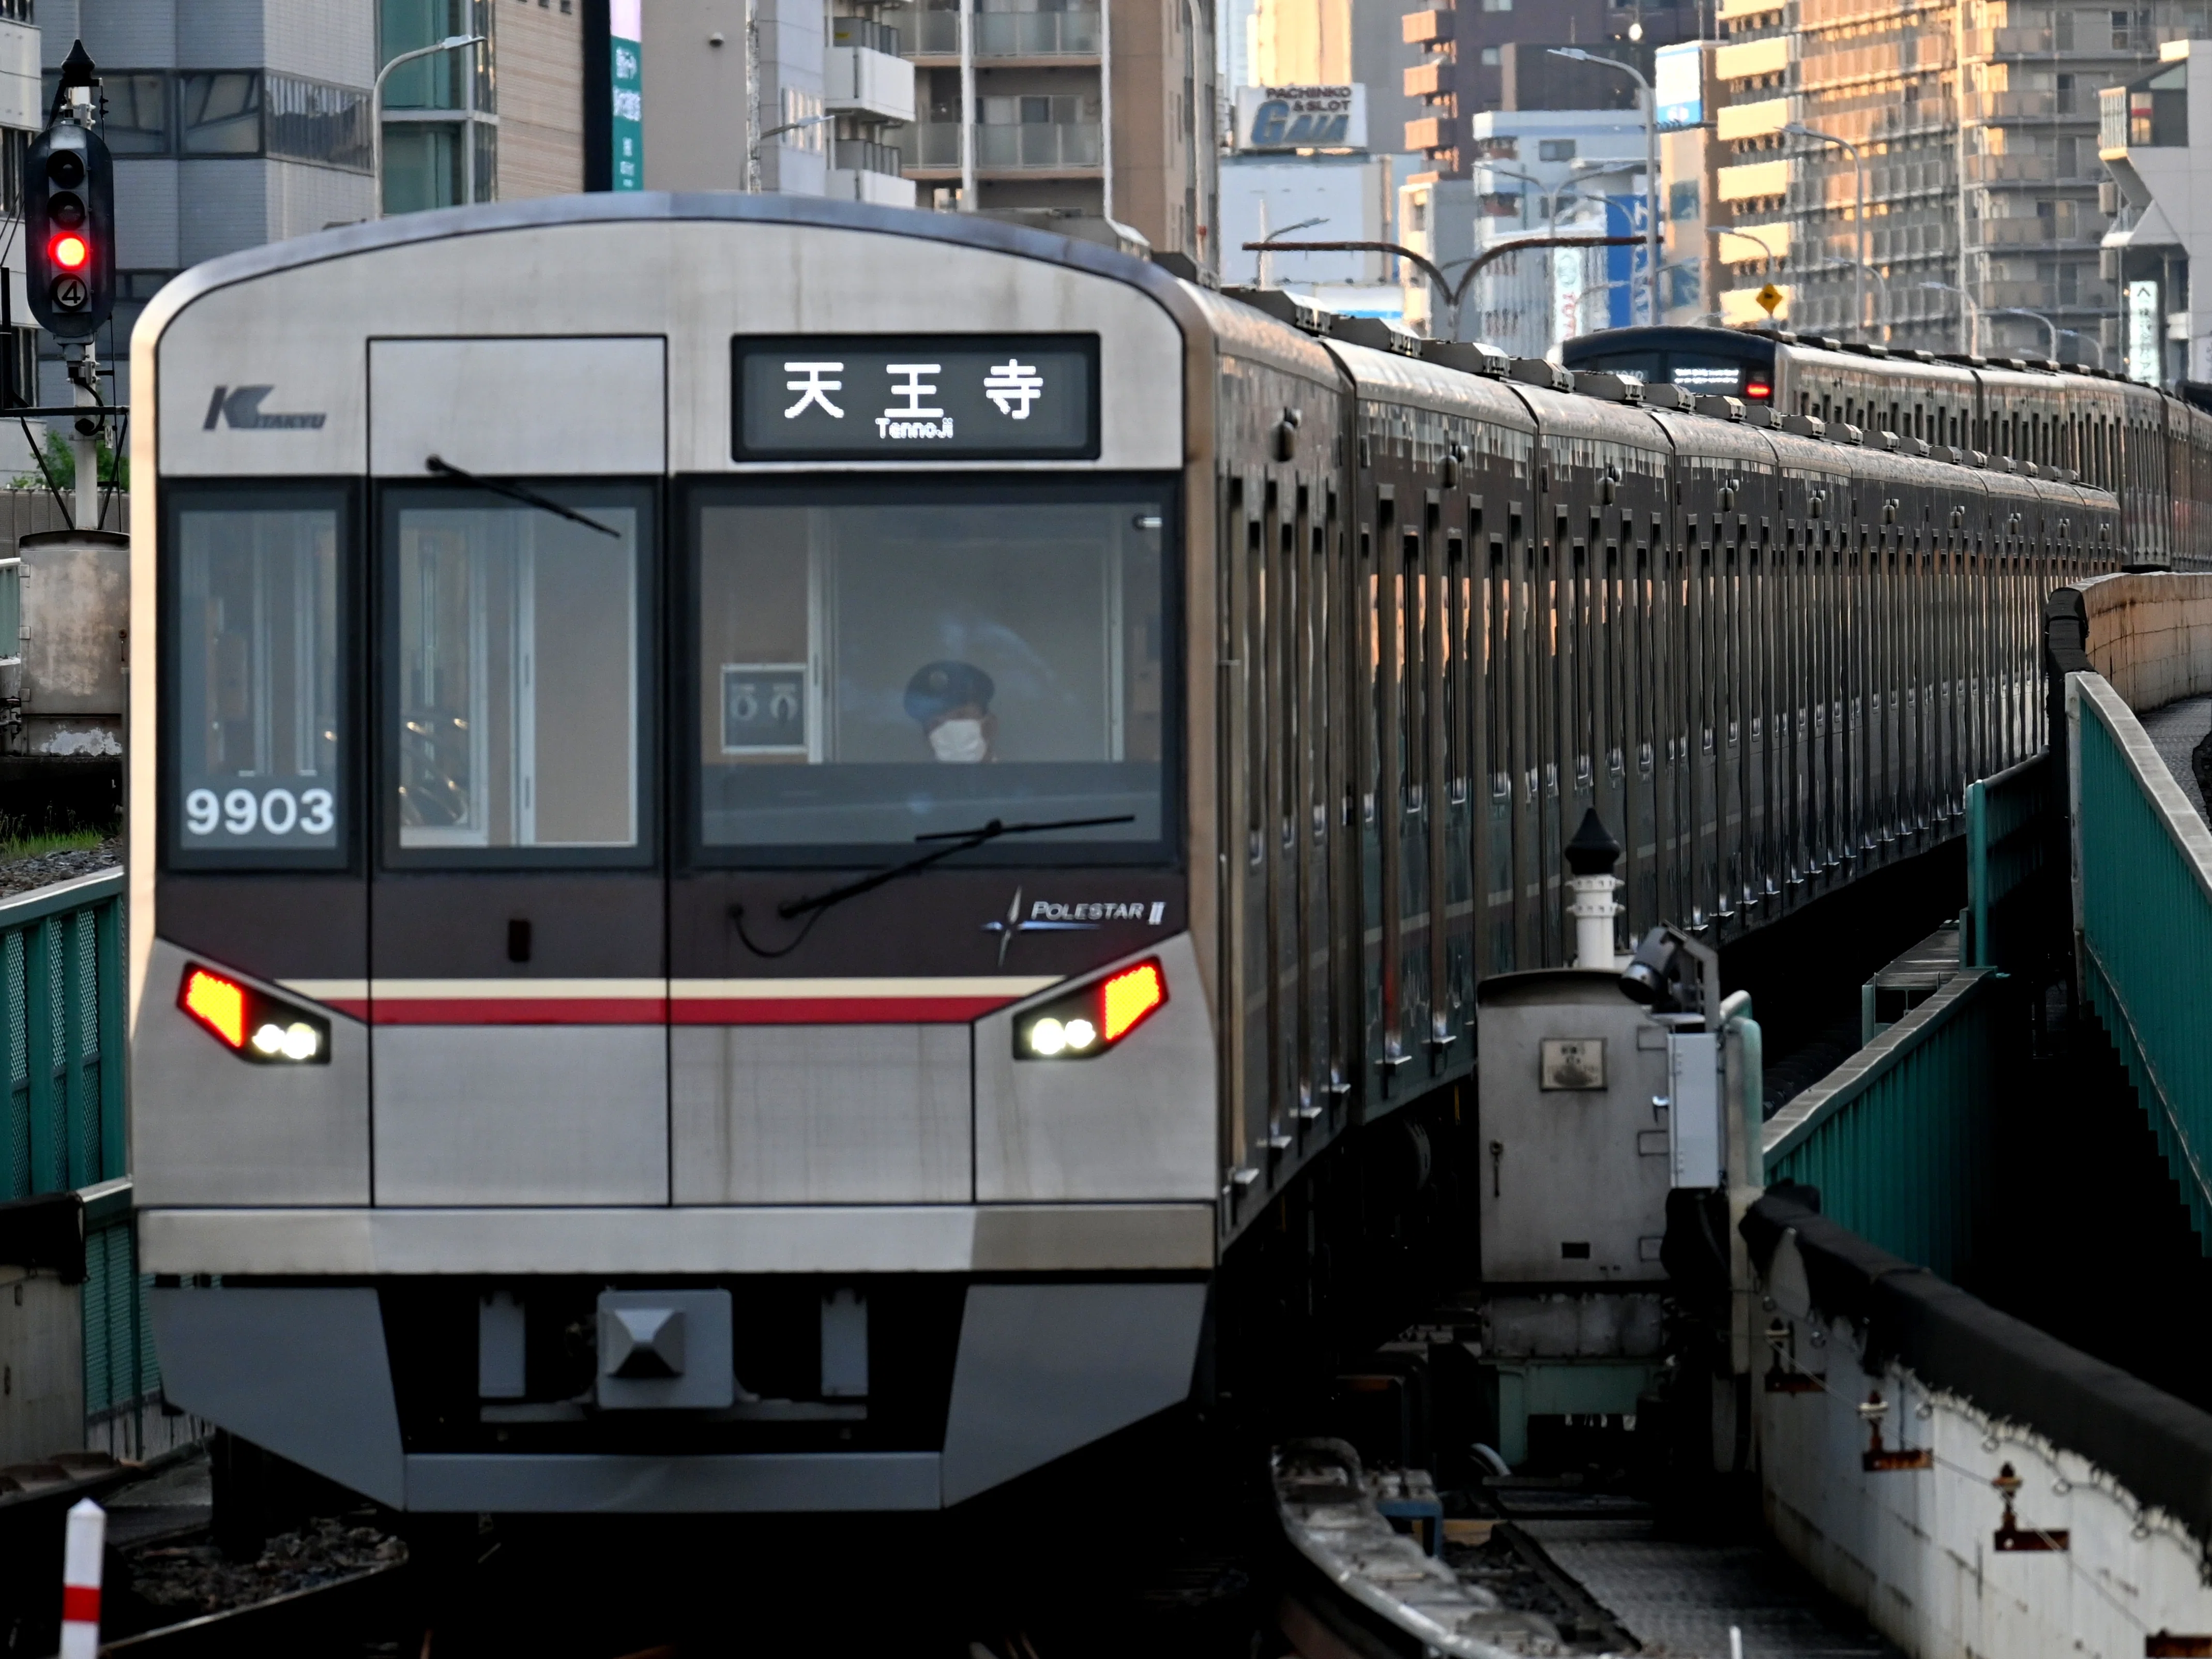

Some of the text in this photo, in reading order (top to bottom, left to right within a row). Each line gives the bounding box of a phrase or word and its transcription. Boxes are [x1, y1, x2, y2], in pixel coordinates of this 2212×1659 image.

[1266, 86, 1351, 99] PACHINKO
[1306, 100, 1351, 111] SLOT
[61, 280, 81, 304] 4
[784, 358, 1043, 419] 天王寺
[875, 417, 953, 439] Tennoji
[186, 788, 335, 835] 9903
[1031, 901, 1145, 921] POLESTAR
